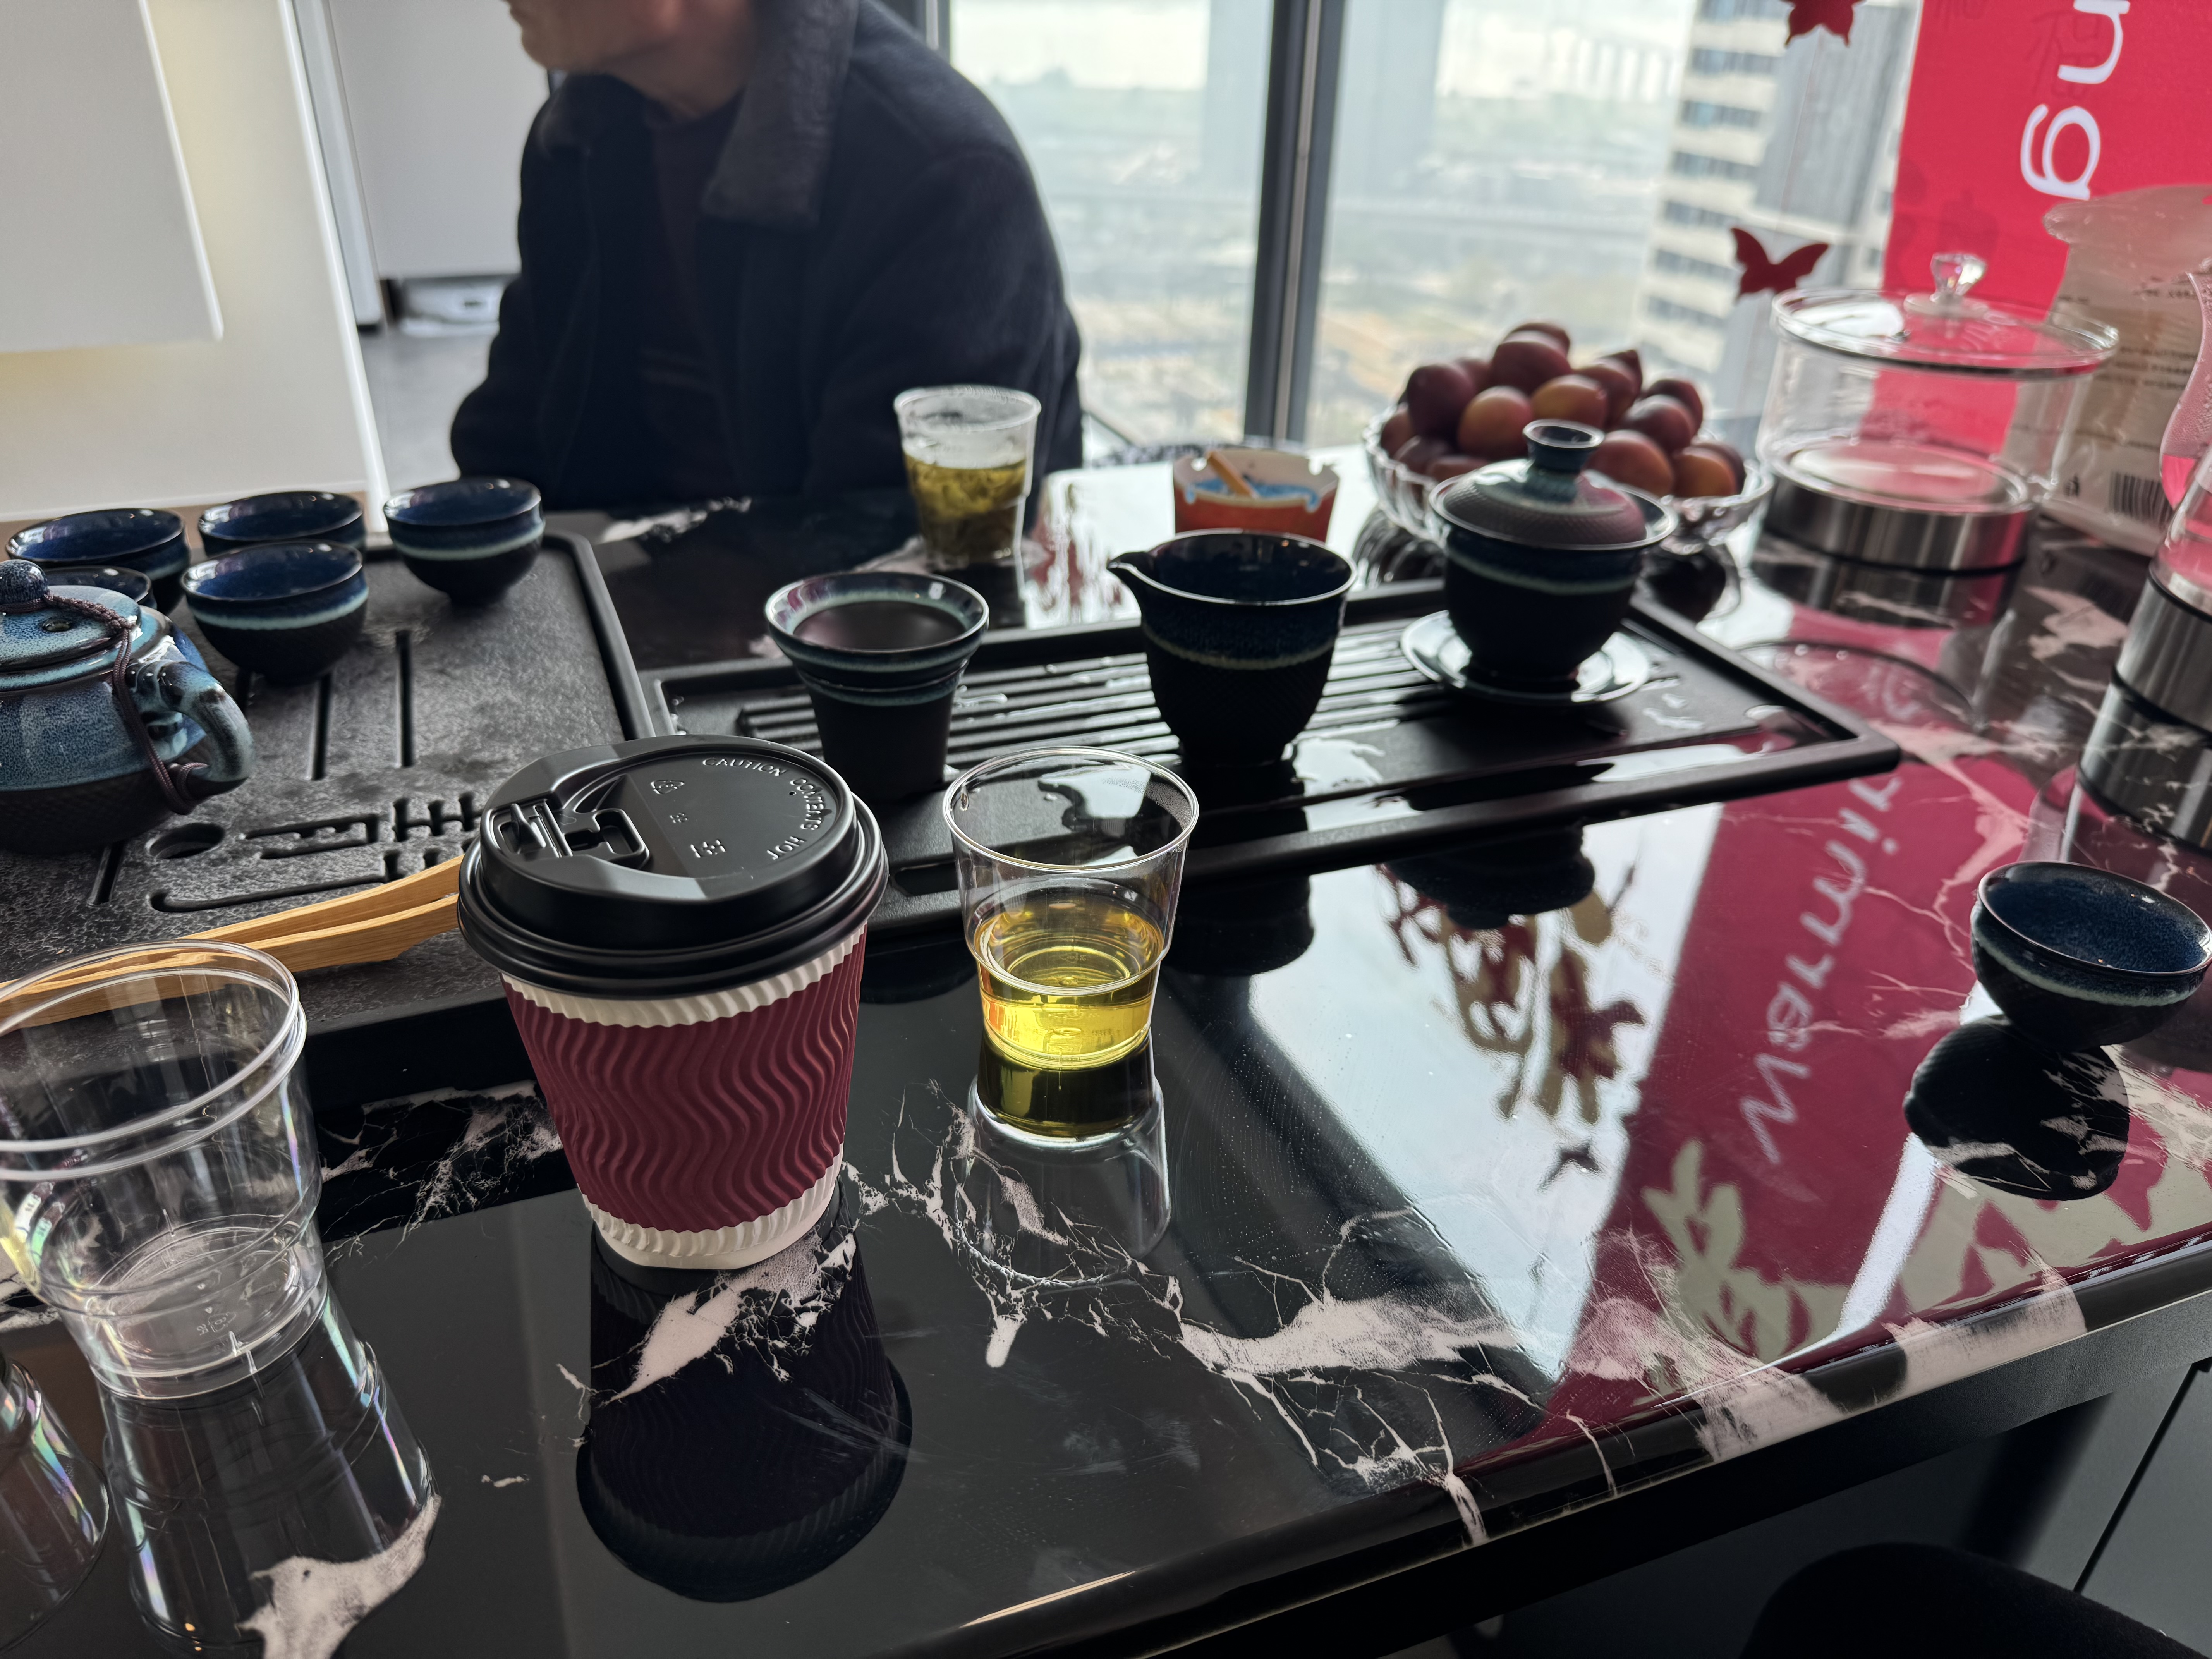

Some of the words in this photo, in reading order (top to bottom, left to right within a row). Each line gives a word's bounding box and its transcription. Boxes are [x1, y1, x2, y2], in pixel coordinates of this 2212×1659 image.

[702, 757, 788, 776] CAUTION
[789, 778, 824, 831] CONTENTS
[766, 836, 807, 860] HOT
